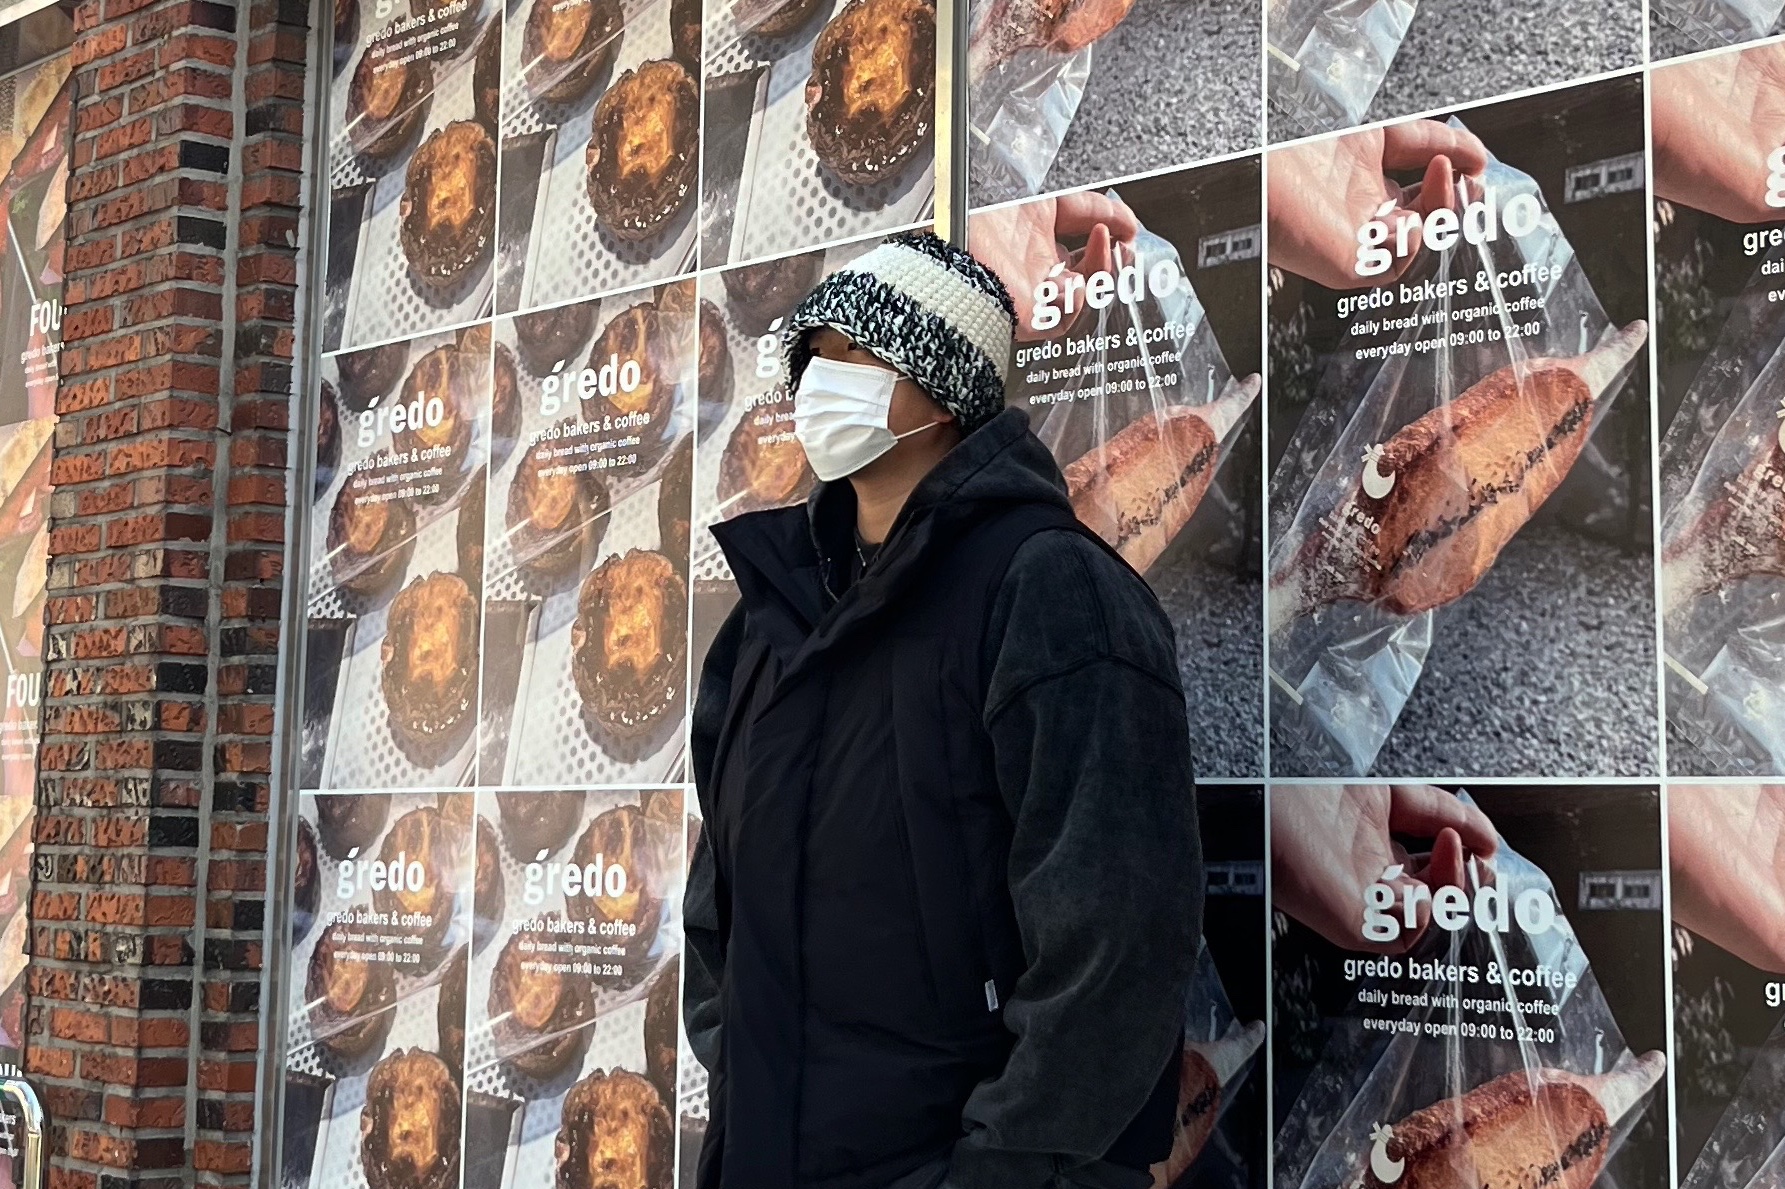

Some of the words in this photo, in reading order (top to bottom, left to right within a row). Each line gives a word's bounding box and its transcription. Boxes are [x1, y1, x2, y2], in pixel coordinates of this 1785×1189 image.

[366, 27, 392, 47] gredo
[395, 13, 425, 34] bakers
[428, 8, 436, 22] &
[438, 0, 467, 20] coffee
[1743, 228, 1785, 256] gre
[1337, 288, 1394, 318] gredo
[1400, 278, 1468, 304] bakers
[1474, 270, 1489, 292] &
[1496, 263, 1563, 288] coffee
[30, 299, 67, 336] FOU
[1351, 320, 1379, 336] daily
[1383, 314, 1418, 331] bread
[1422, 311, 1448, 325] with
[1451, 302, 1499, 322] organic
[1504, 296, 1545, 313] coffee
[1016, 341, 1061, 368] gredo
[1067, 332, 1120, 356] bakers
[1125, 327, 1138, 345] &
[1143, 320, 1196, 343] coffee
[1356, 341, 1412, 360] everyday
[1414, 337, 1446, 354] open
[1450, 330, 1484, 346] 09:00
[1488, 328, 1501, 341] to
[1504, 322, 1540, 338] 22:00
[1026, 368, 1050, 383] daily
[1052, 364, 1081, 379] bread
[1083, 362, 1104, 375] with
[1107, 356, 1146, 374] organic
[1149, 350, 1181, 365] coffee
[744, 389, 782, 412] gredo
[1029, 388, 1075, 405] everyday
[1078, 385, 1102, 400] open
[1106, 381, 1133, 394] 09:00
[1135, 379, 1146, 389] to
[1149, 374, 1177, 388] 22:00
[530, 427, 560, 446] gredo
[563, 421, 600, 437] bakers
[603, 415, 611, 431] &
[615, 411, 650, 429] coffee
[348, 458, 374, 476] gredo
[377, 452, 408, 467] bakers
[411, 448, 418, 462] &
[421, 444, 451, 460] coffee
[327, 911, 354, 926] gredo
[357, 910, 388, 925] bakers
[391, 910, 398, 925] &
[401, 911, 432, 927] coffee
[512, 919, 544, 934] gredo
[547, 917, 584, 934] bakers
[588, 918, 596, 934] &
[600, 919, 636, 936] coffee
[1344, 957, 1402, 980] gredo
[1409, 958, 1479, 983] bakers
[1486, 961, 1501, 984] &
[1509, 964, 1578, 988] coffee
[1358, 989, 1388, 1007] daily
[1391, 990, 1428, 1007] bread
[1431, 994, 1459, 1009] with
[1462, 997, 1512, 1014] organic
[1517, 1000, 1559, 1016] coffee
[1363, 1017, 1421, 1037] everyday
[1424, 1022, 1457, 1038] open
[1461, 1023, 1496, 1039] 09:00
[1500, 1025, 1513, 1040] to
[1517, 1026, 1554, 1043] 22:00
